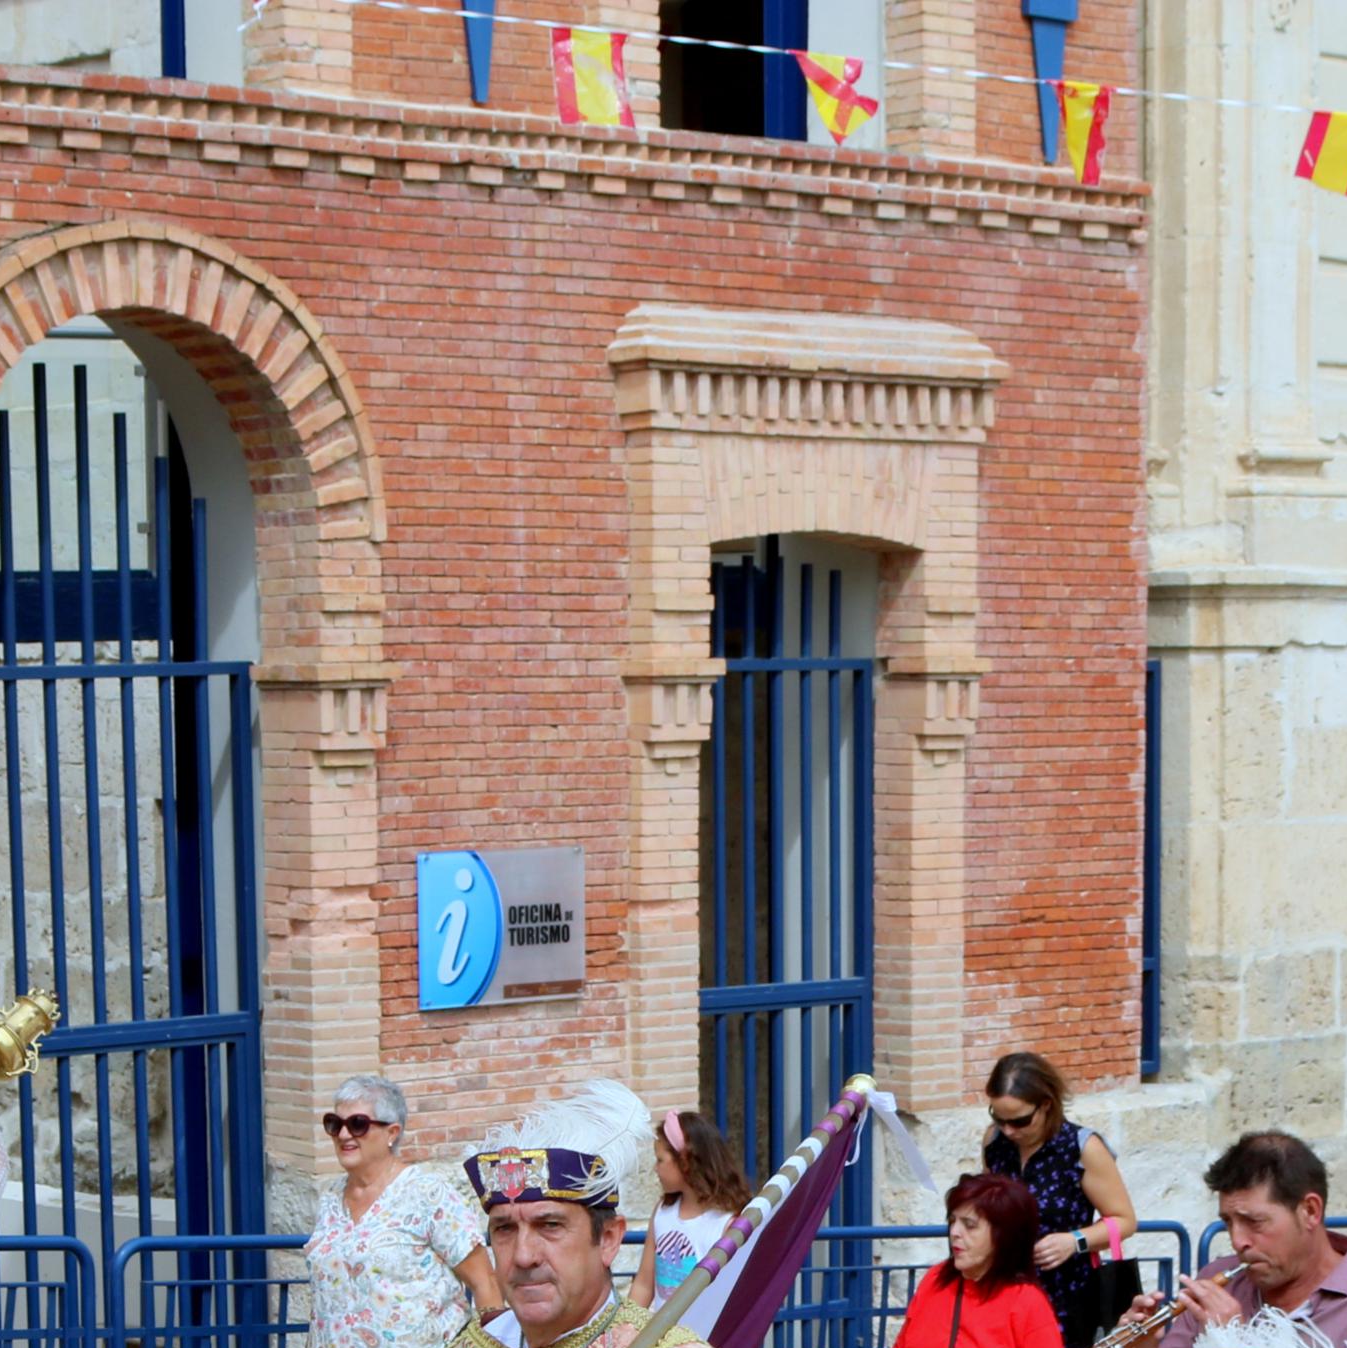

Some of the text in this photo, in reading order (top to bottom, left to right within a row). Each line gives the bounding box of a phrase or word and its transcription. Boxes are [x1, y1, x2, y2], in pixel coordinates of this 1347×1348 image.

[508, 903, 574, 925] OFICINA DE
[508, 924, 570, 947] TURISMO
